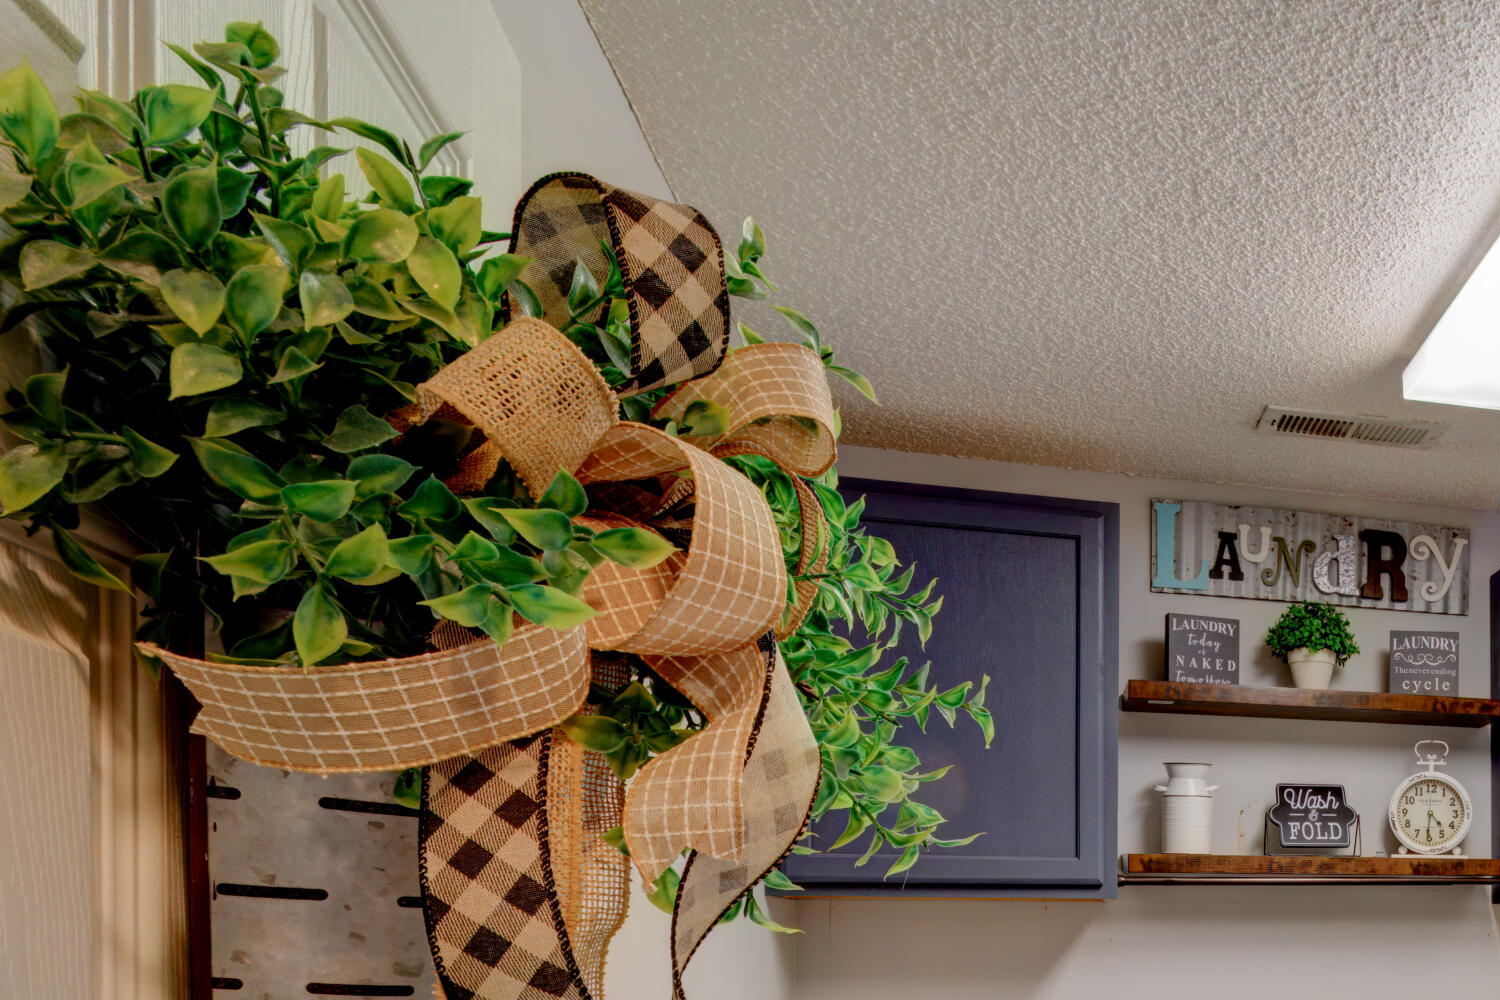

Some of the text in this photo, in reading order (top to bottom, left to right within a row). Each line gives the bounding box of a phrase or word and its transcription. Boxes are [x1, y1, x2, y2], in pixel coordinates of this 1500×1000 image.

[1173, 618, 1236, 636] LAUNDRY
[1187, 632, 1221, 653] today
[1393, 636, 1458, 652] LAUNDRY
[1176, 655, 1236, 671] NAKED
[1431, 668, 1456, 676] ending
[1402, 678, 1450, 693] cycle
[1415, 788, 1423, 796] 11
[1426, 784, 1437, 793] 12
[1442, 788, 1445, 797] 1
[1284, 788, 1339, 809] Wash
[1405, 796, 1414, 804] 10
[1450, 798, 1455, 806] 2
[1309, 809, 1319, 821] &
[1402, 809, 1408, 817] 9
[1453, 810, 1458, 818] 3
[1405, 820, 1410, 828] 8
[1449, 821, 1454, 829] 4
[1288, 822, 1341, 839] FOLD
[1415, 830, 1420, 838] 7
[1439, 830, 1444, 838] 5
[1427, 833, 1432, 842] 6
